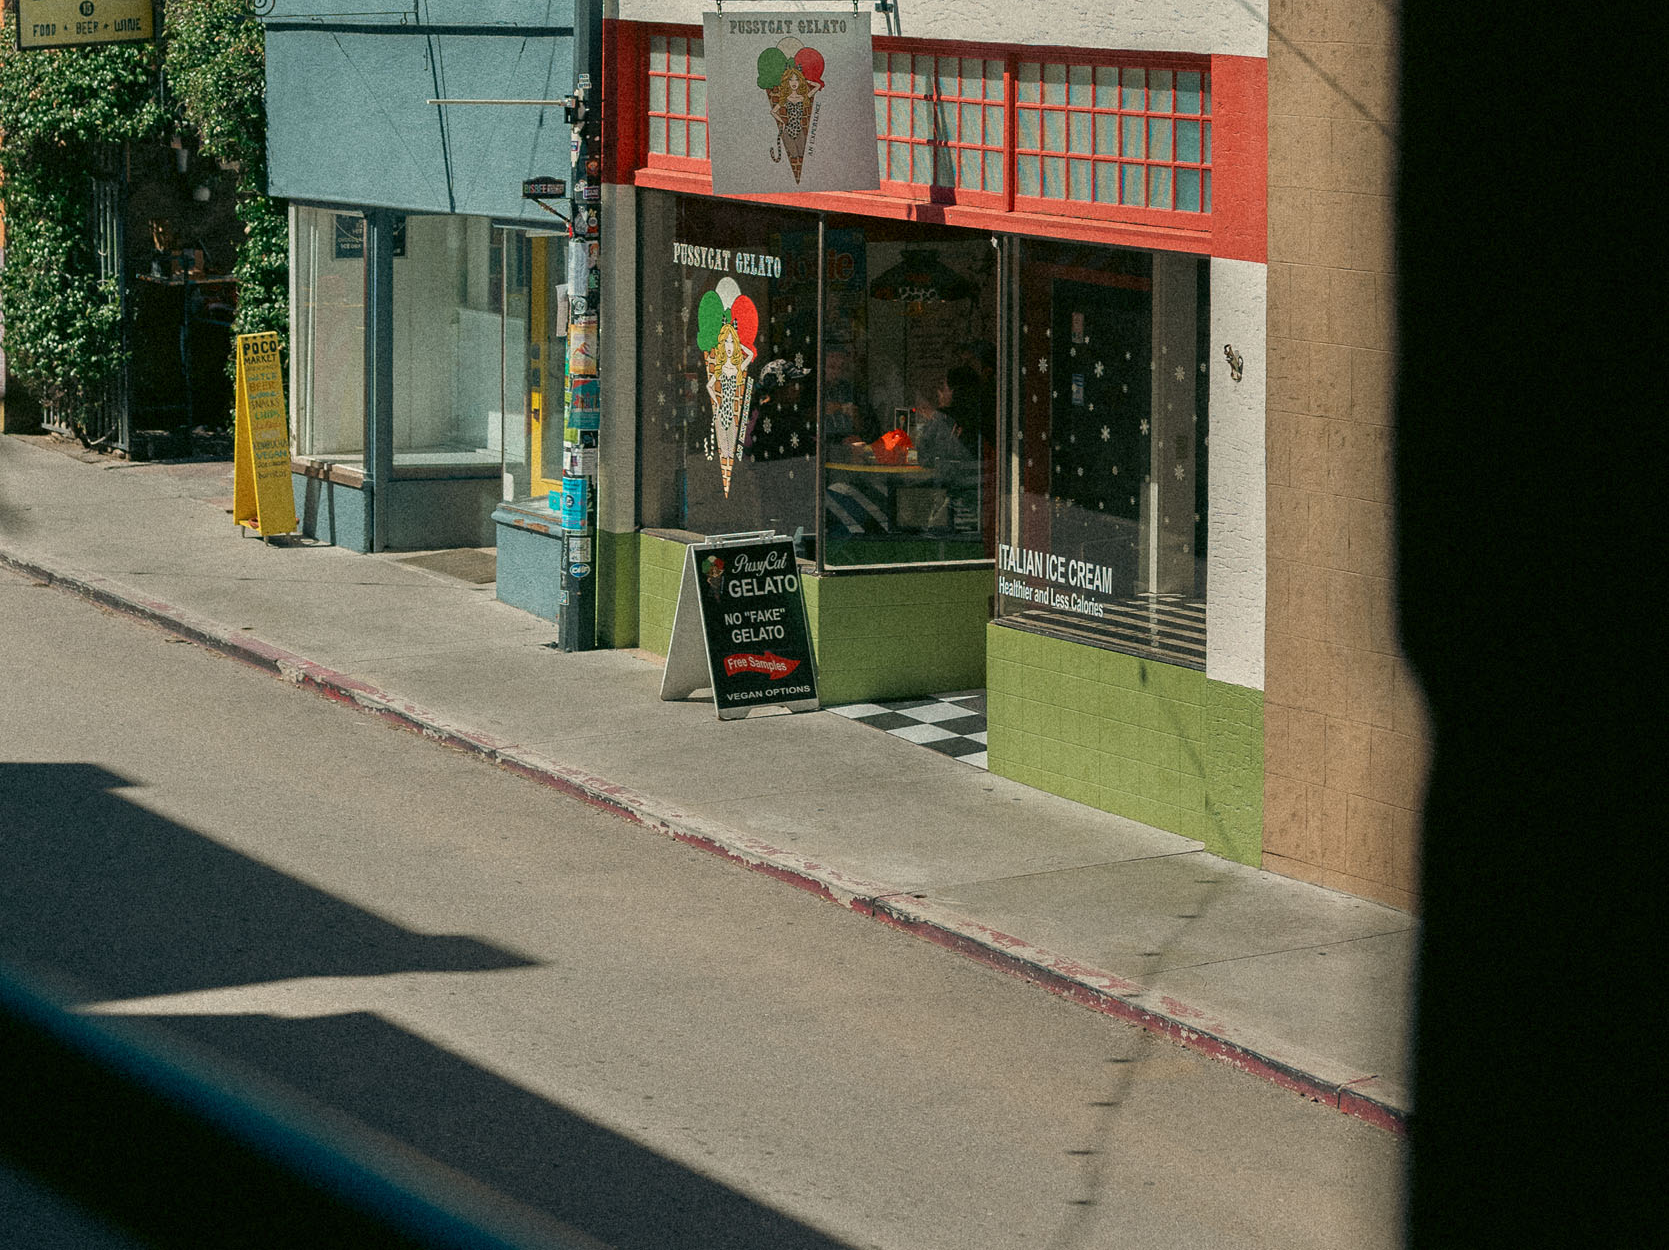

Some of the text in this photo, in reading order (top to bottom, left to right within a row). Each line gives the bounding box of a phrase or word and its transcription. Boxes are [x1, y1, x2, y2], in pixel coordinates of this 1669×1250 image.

[33, 18, 141, 37] FOOD BEER WINE
[729, 19, 847, 34] PUSSYCAT GELATO
[673, 242, 782, 278] PUSSYCAT GELATO
[243, 340, 277, 356] POCO
[244, 354, 276, 365] MARKET
[999, 544, 1113, 594] ITALIAN ICE CREAM
[728, 576, 798, 598] GELATO
[999, 576, 1104, 618] Healthier and Less Calories
[724, 608, 785, 626] NO "FAKE"
[731, 625, 785, 644] GELATO
[727, 656, 788, 672] Free Samples
[727, 685, 811, 701] VEGAN OPTIONS
